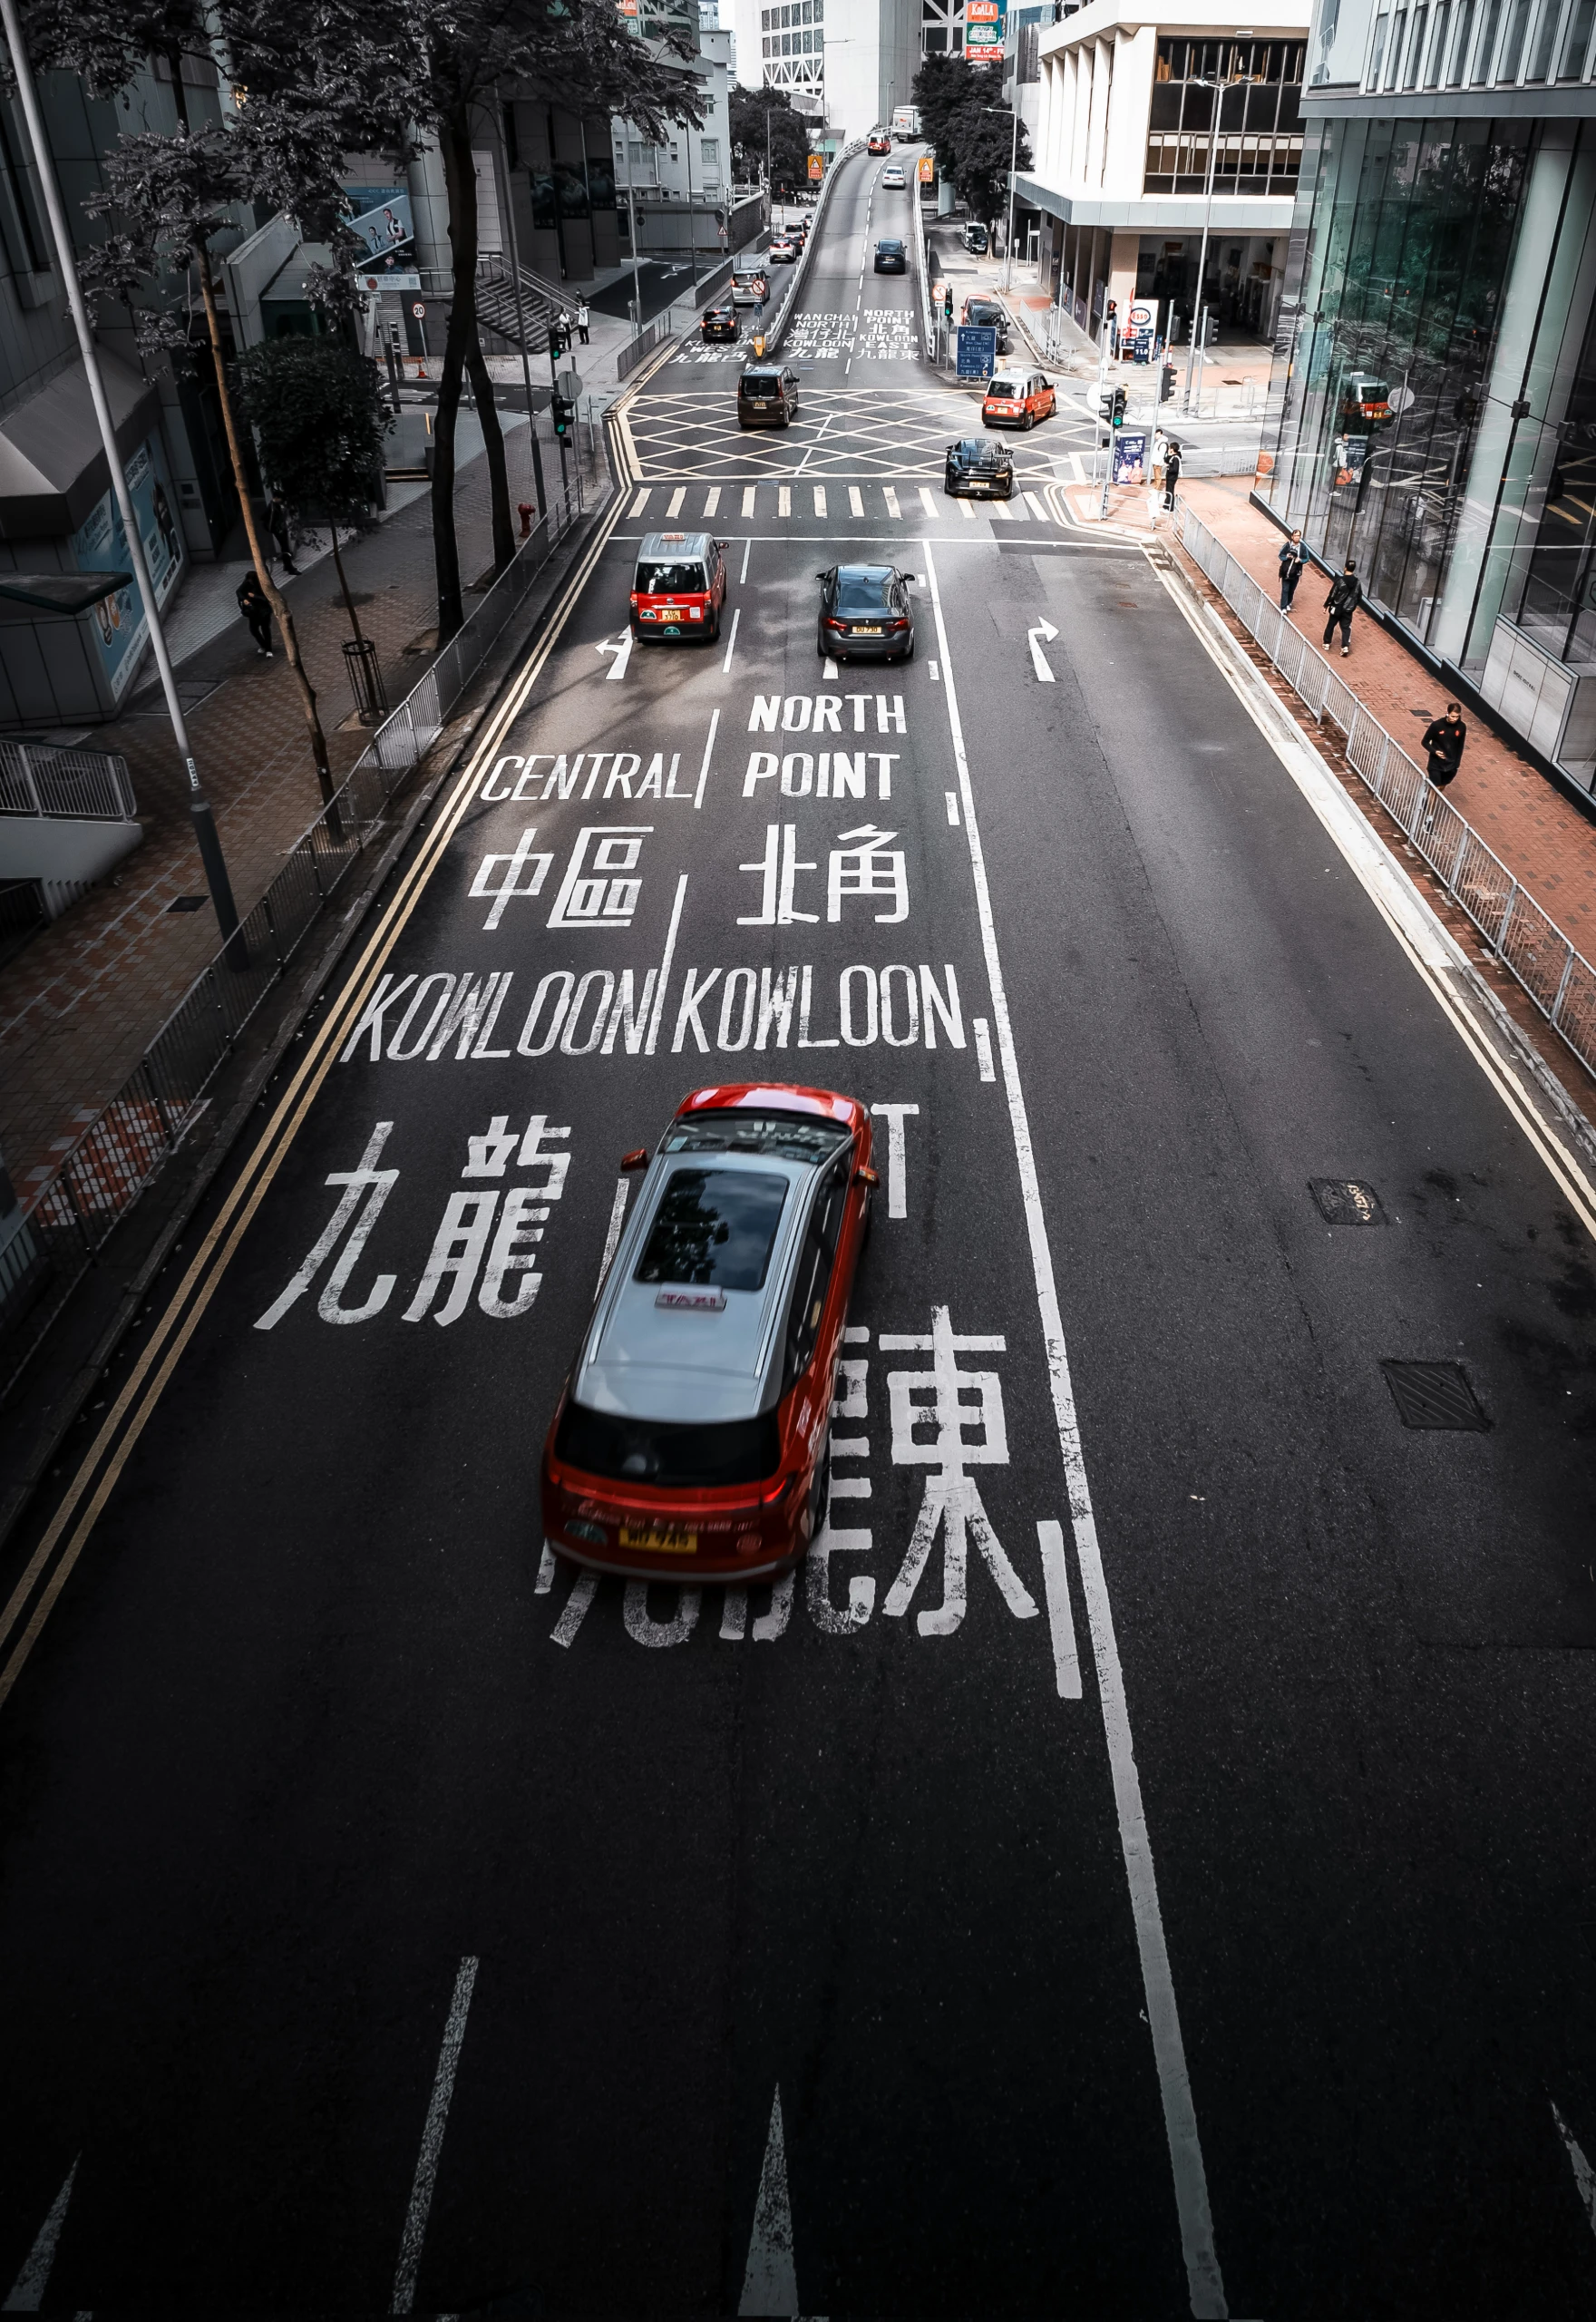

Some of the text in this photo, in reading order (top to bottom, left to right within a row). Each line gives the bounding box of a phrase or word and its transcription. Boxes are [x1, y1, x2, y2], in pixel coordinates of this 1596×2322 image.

[414, 307, 423, 315] 20
[794, 313, 826, 321] WAN
[863, 309, 915, 317] NORTH
[796, 320, 850, 329] NORTH
[866, 317, 912, 325] POINT
[787, 328, 852, 341] 灣仔北
[869, 324, 910, 336] 北角
[783, 339, 852, 348] KOWLOON
[860, 334, 919, 343] KOWLOON
[865, 341, 912, 349] EAST
[668, 351, 748, 364] 九龍西
[787, 346, 840, 359] 九龍
[856, 348, 920, 361] 九龍東
[747, 694, 907, 734] NORTH
[480, 753, 694, 801] CENTRAL
[742, 752, 900, 800] POINT
[468, 827, 654, 930] 中區
[736, 824, 910, 926] 北角
[671, 963, 968, 1053] KOWLOON
[339, 969, 658, 1062] KOWLOON
[253, 1115, 571, 1330] 九龍
